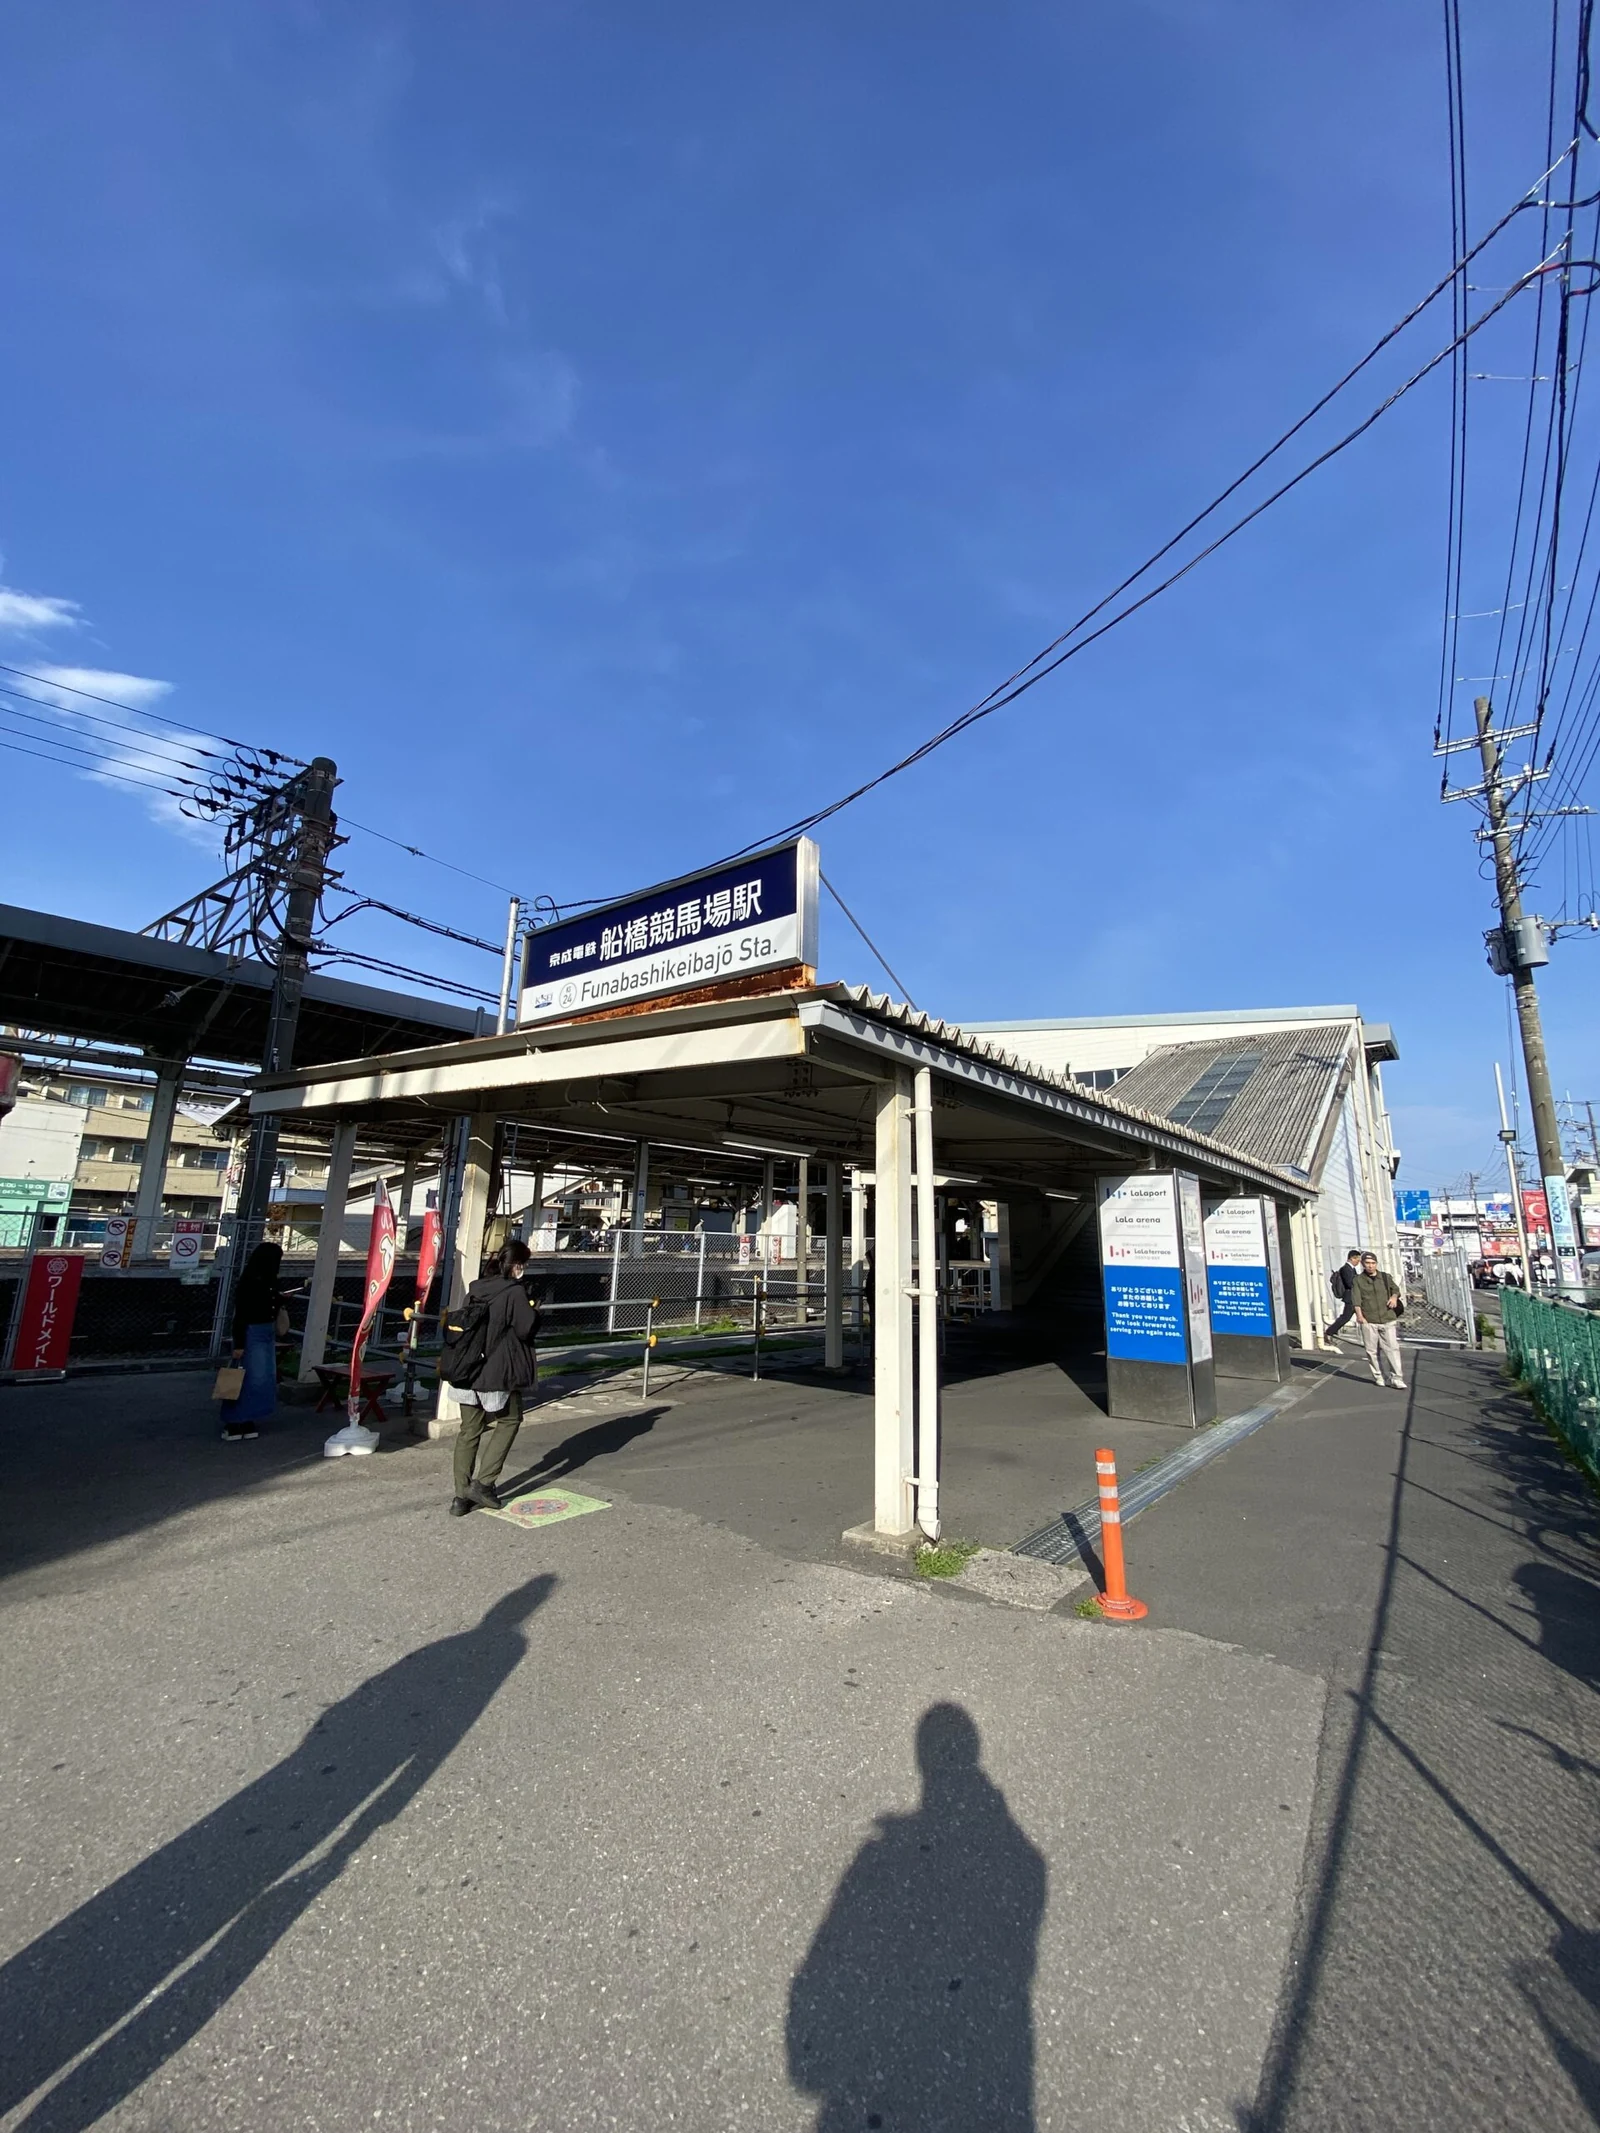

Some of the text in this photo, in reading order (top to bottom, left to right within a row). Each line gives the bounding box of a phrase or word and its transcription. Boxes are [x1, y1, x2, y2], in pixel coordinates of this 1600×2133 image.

[549, 878, 762, 968] 京成電鉄 船橋競馬場駅
[580, 937, 778, 1002] Funabashikeibajō Sta.
[562, 994, 572, 1005] 24
[1130, 1190, 1167, 1198] LaLaport
[1111, 1285, 1176, 1296] ありがとうございました
[1123, 1294, 1164, 1303] またのお越しを
[1117, 1301, 1171, 1310] お待ちしております
[34, 1275, 63, 1368] ワールドメイト
[1142, 1321, 1167, 1329] forward
[1110, 1326, 1132, 1335] serving
[1146, 1329, 1164, 1337] again
